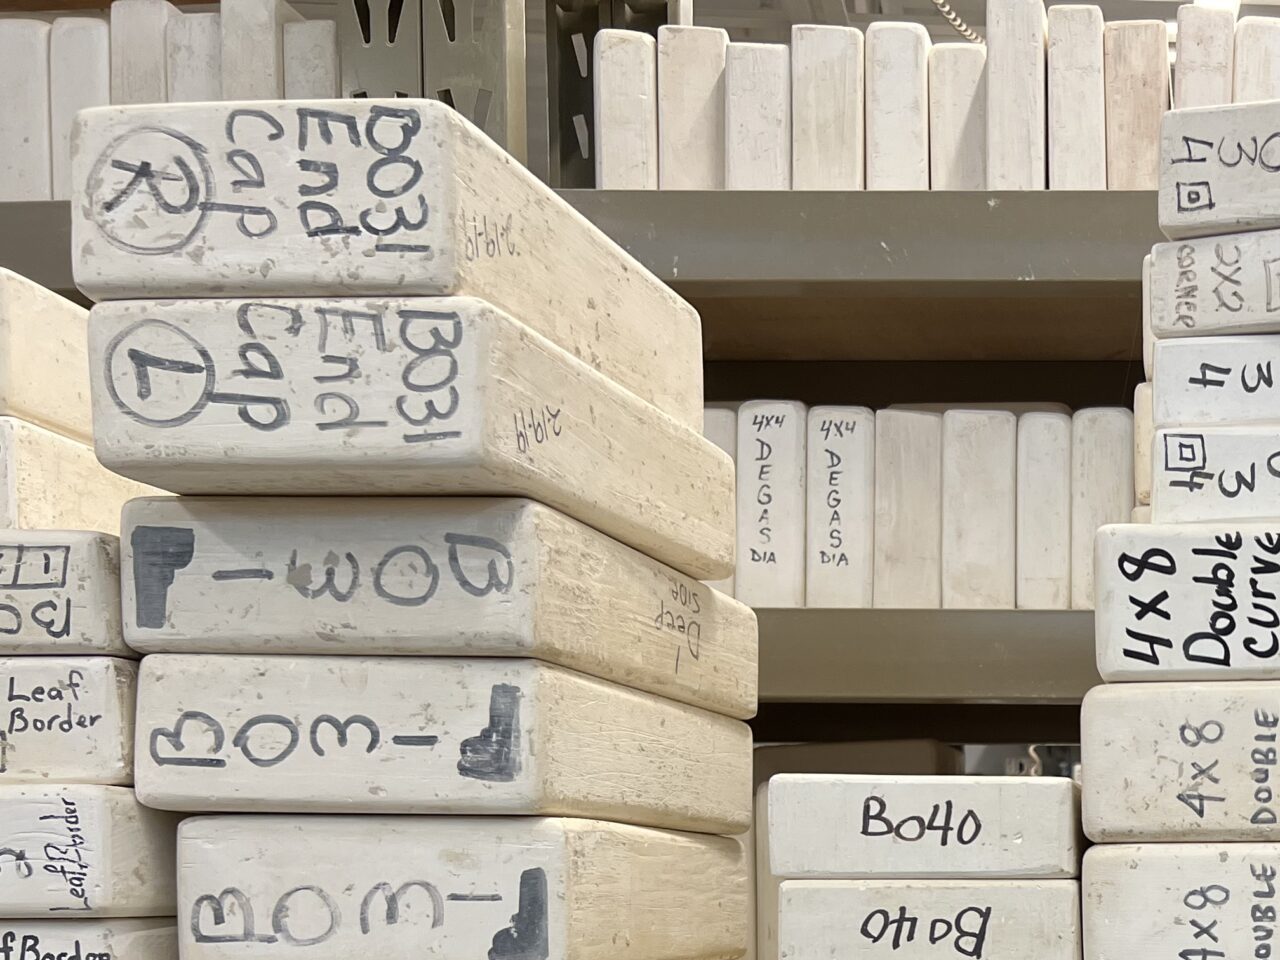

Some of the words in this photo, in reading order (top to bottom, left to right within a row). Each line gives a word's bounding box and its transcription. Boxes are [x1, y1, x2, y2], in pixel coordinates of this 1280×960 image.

[103, 156, 200, 214] R
[201, 109, 283, 239] Cap
[299, 107, 362, 238] End
[1174, 244, 1197, 329] CORNER
[205, 303, 301, 431] Cap
[315, 307, 389, 431] End
[755, 438, 773, 545] DEGAS
[824, 449, 843, 549] DEGAS
[750, 548, 777, 564] DIA
[819, 550, 849, 567] DIA
[7, 669, 85, 703] Leaf
[7, 702, 104, 735] Border
